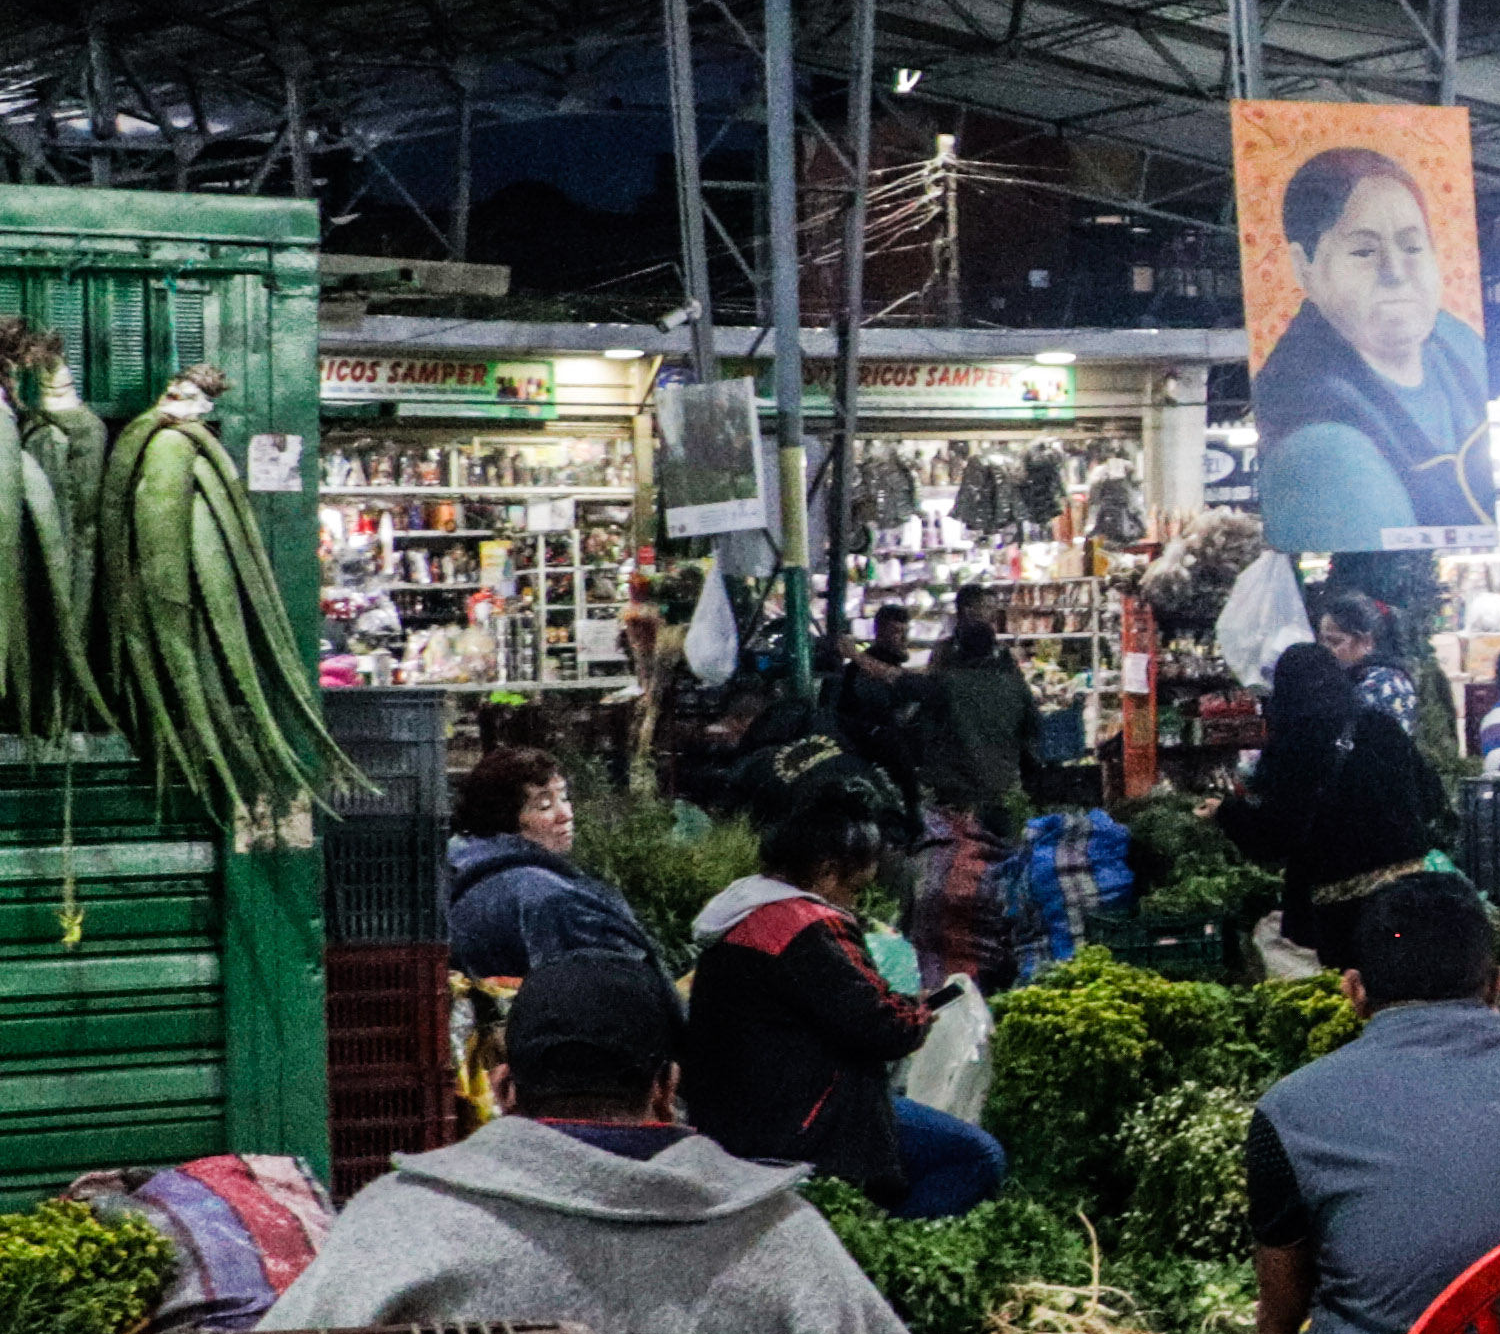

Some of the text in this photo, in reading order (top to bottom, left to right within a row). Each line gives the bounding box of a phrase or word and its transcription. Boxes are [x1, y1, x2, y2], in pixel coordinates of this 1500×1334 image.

[318, 359, 488, 386] ICOS SAMPER
[924, 364, 1013, 388] SAMPER
